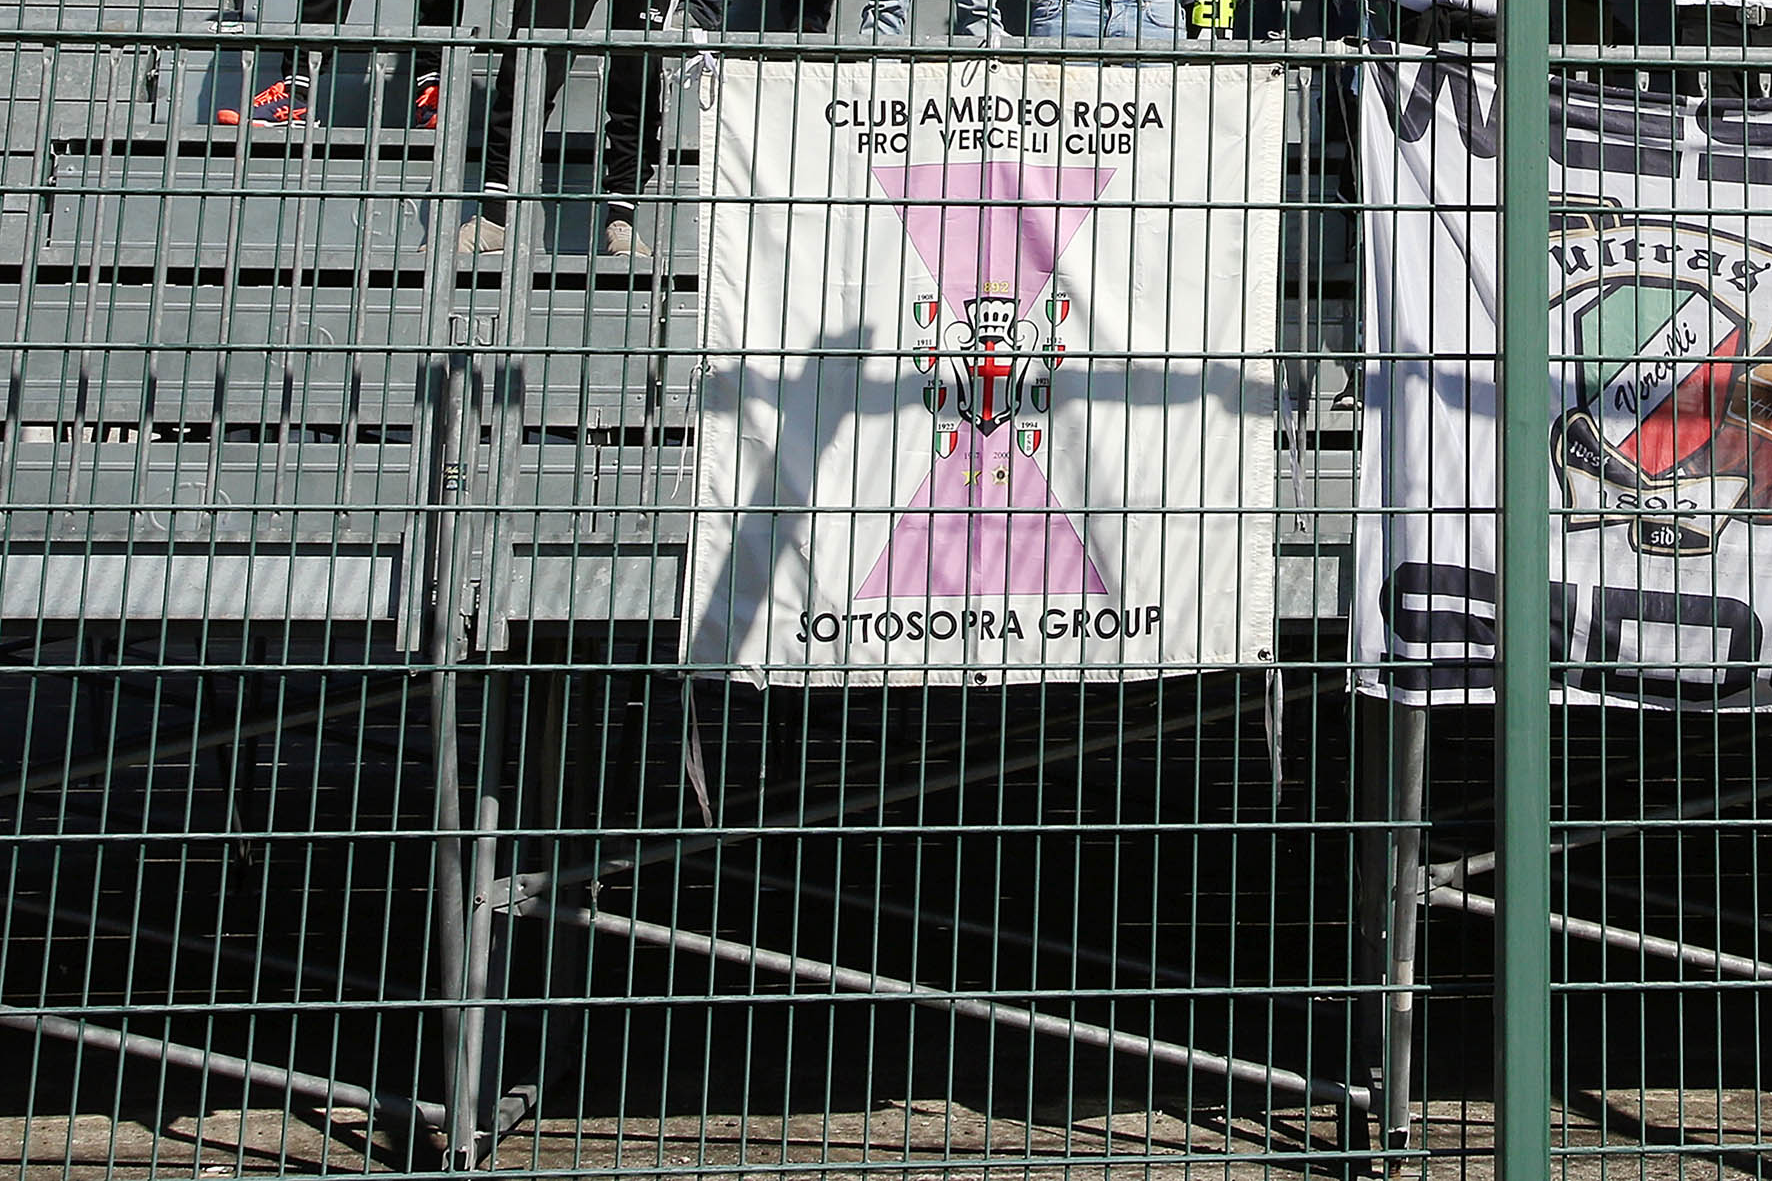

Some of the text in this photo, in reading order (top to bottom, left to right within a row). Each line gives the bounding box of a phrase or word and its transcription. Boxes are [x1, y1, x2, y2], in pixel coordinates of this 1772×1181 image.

[825, 95, 1164, 129] CLUB AMEDEO ROSA
[858, 132, 908, 154] PRO
[1065, 132, 1131, 155] CLUB
[1549, 237, 1771, 293] ultras
[977, 282, 1009, 293] 892
[1614, 322, 1697, 414] Vercelli
[796, 606, 1162, 644] SOTTOSOPRA GROUP
